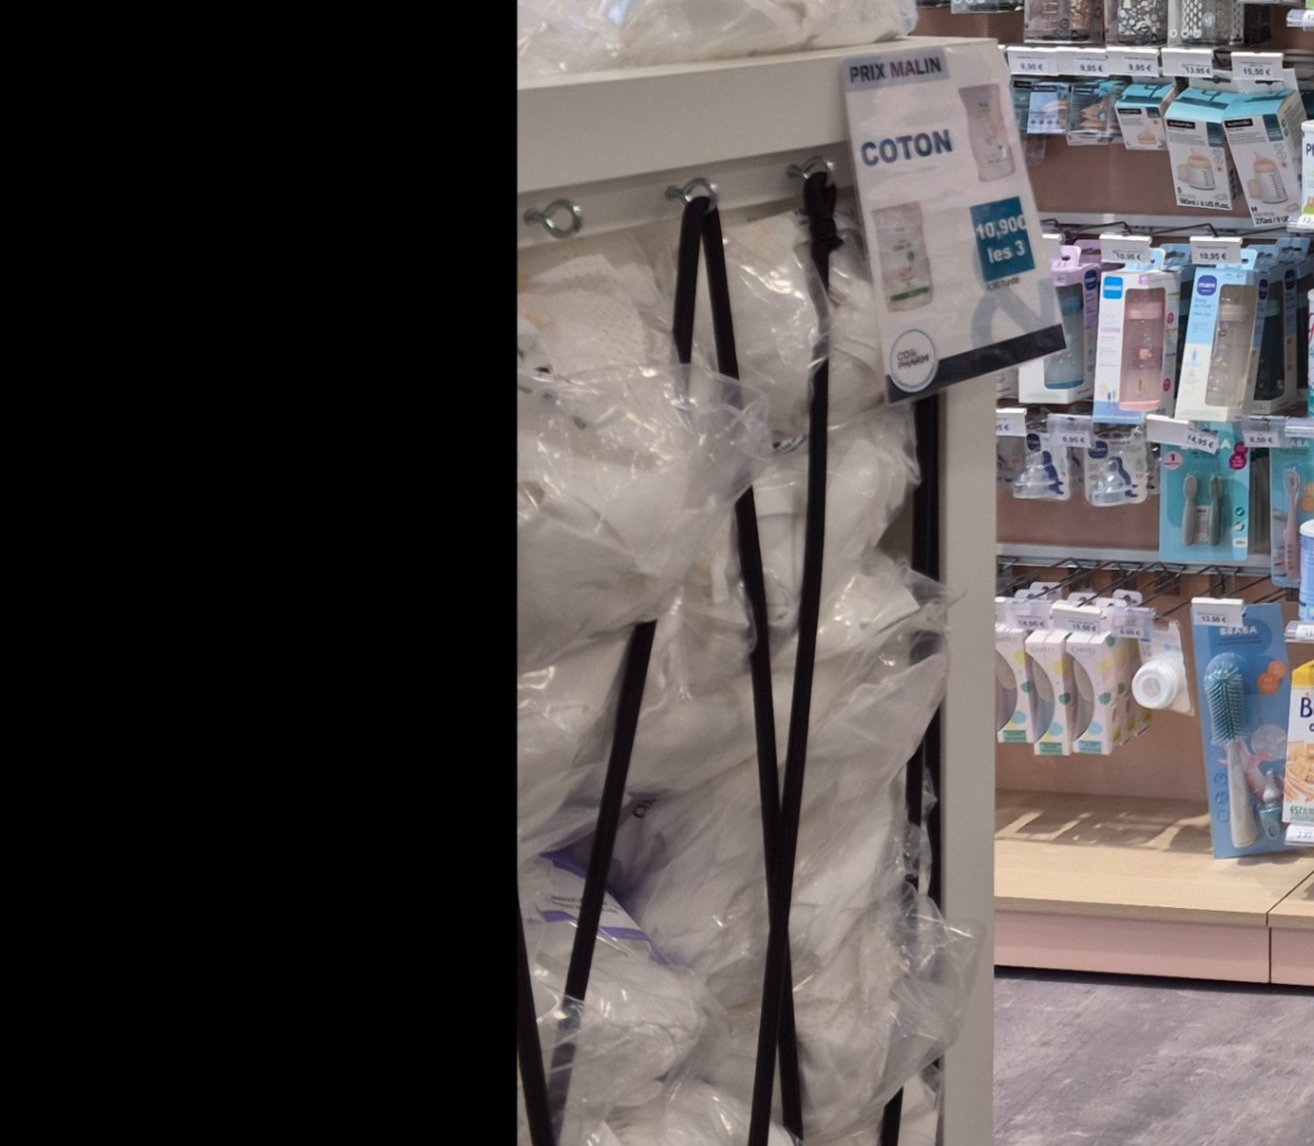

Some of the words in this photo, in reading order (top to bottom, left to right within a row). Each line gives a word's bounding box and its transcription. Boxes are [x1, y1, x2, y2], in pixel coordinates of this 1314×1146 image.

[849, 63, 885, 84] PRIX
[889, 57, 942, 79] MALIN
[860, 128, 953, 167] COTON
[987, 244, 1013, 264] les
[1015, 240, 1026, 258] 3
